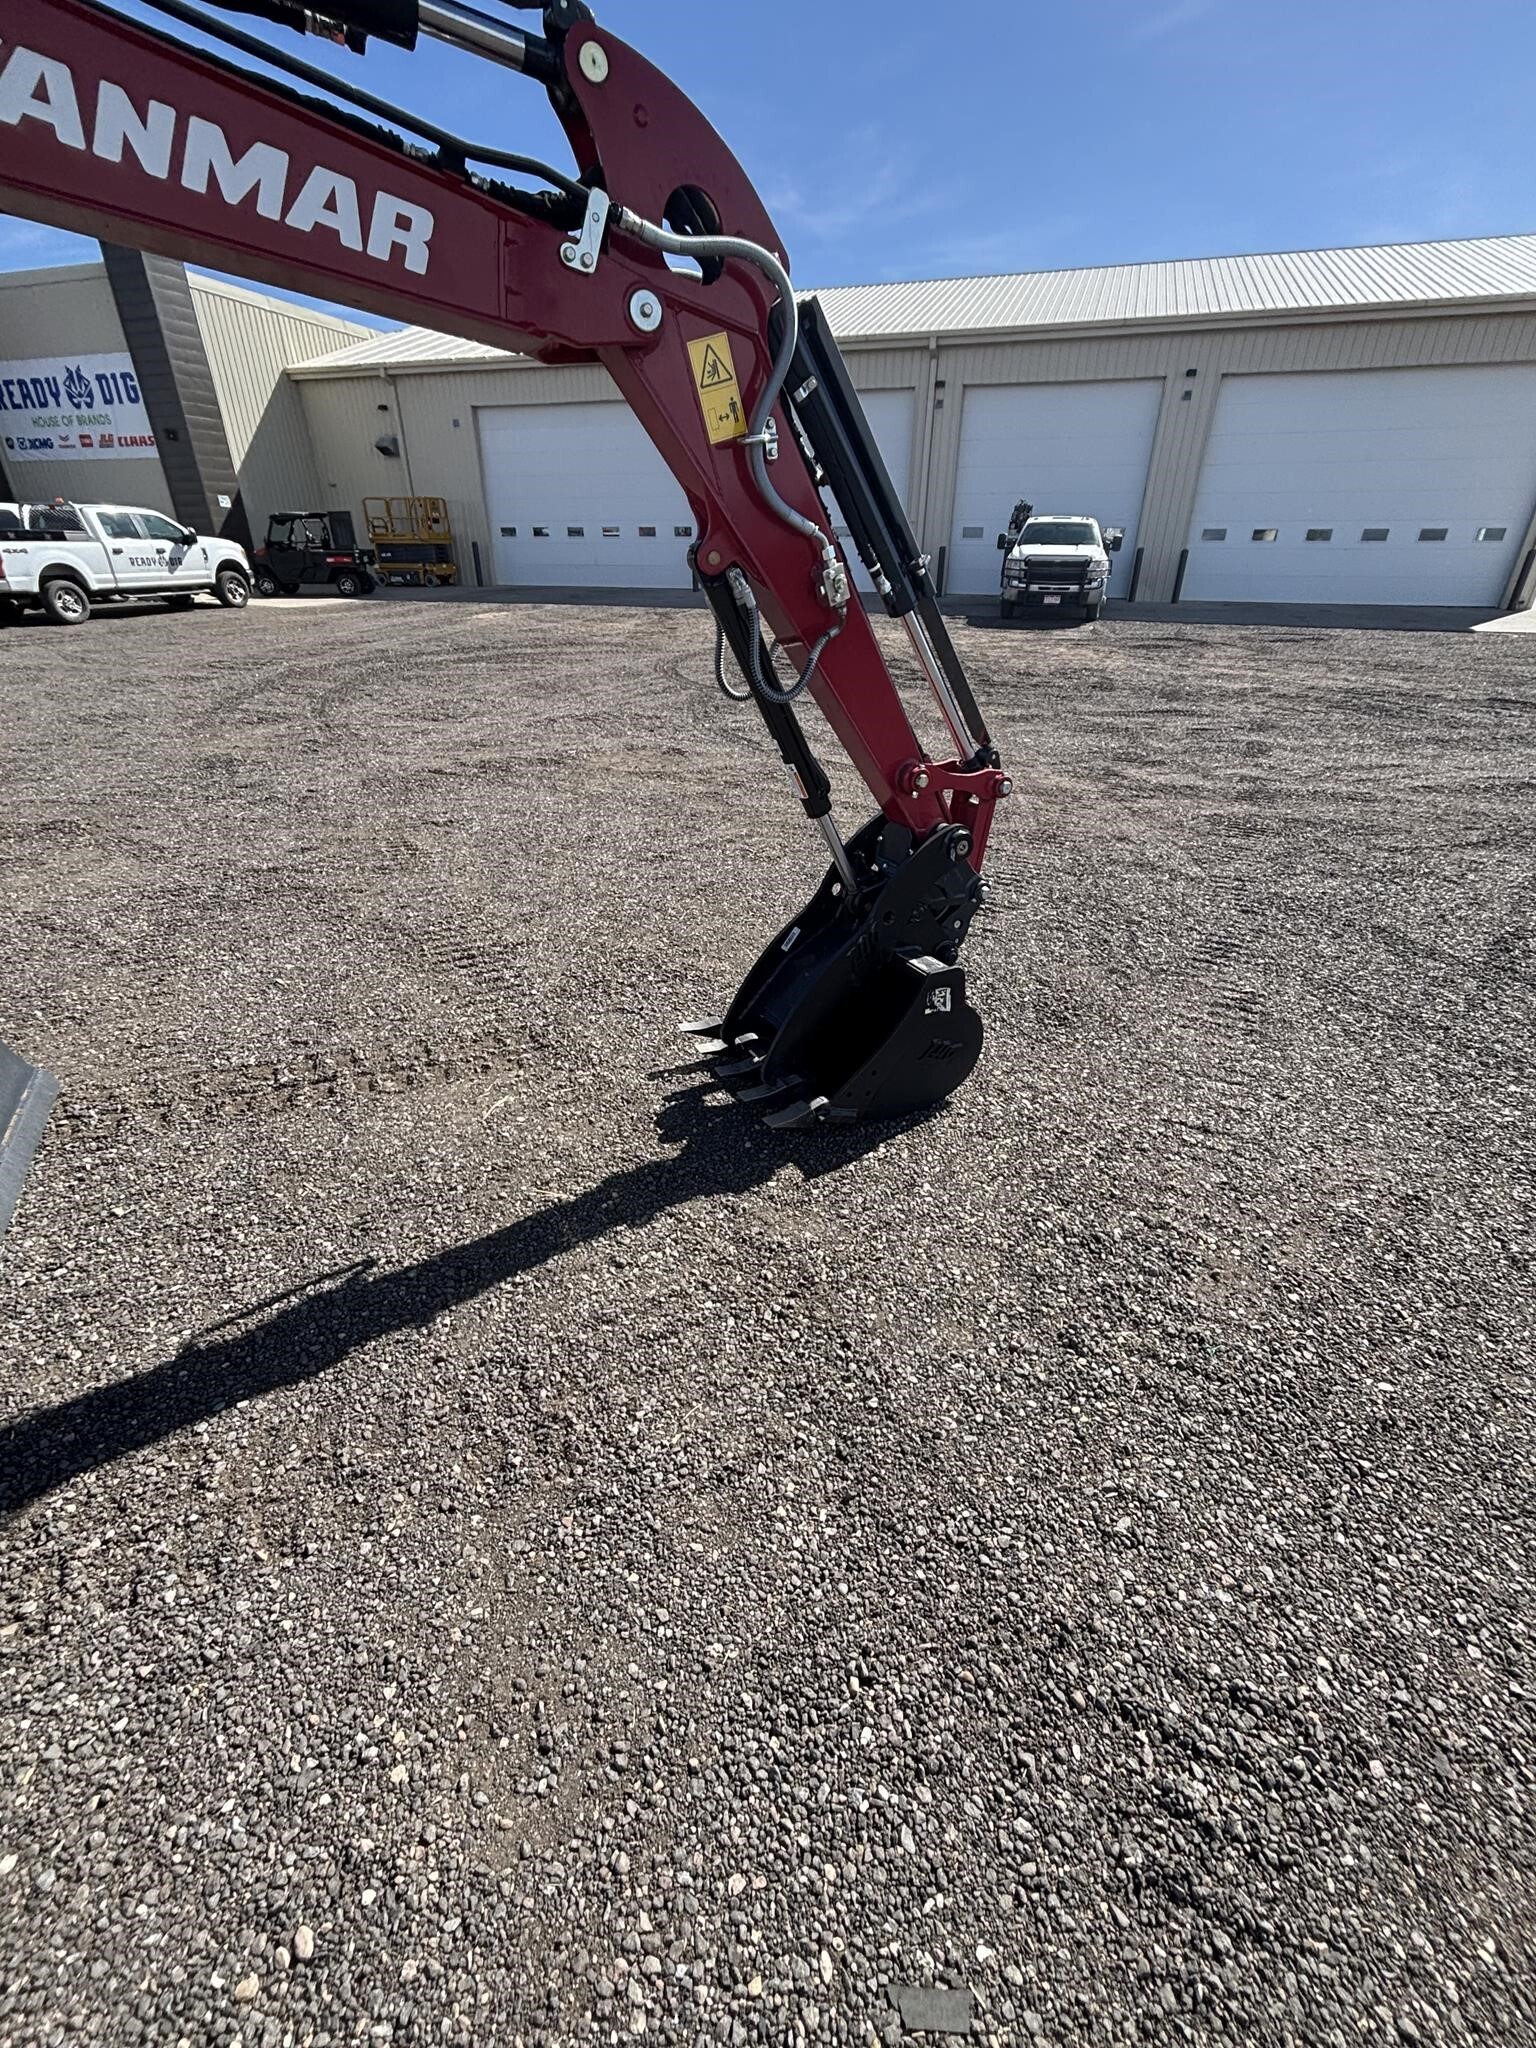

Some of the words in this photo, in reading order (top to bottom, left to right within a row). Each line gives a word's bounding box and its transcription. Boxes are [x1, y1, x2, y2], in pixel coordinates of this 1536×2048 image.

[0, 39, 434, 276] ANMAR
[95, 371, 141, 405] DIG
[32, 415, 61, 428] HOUSE
[62, 415, 73, 427] OF
[77, 413, 112, 426] BRANDS
[27, 437, 54, 450] XCMG
[117, 435, 156, 448] CLAAS
[128, 557, 157, 567] READY
